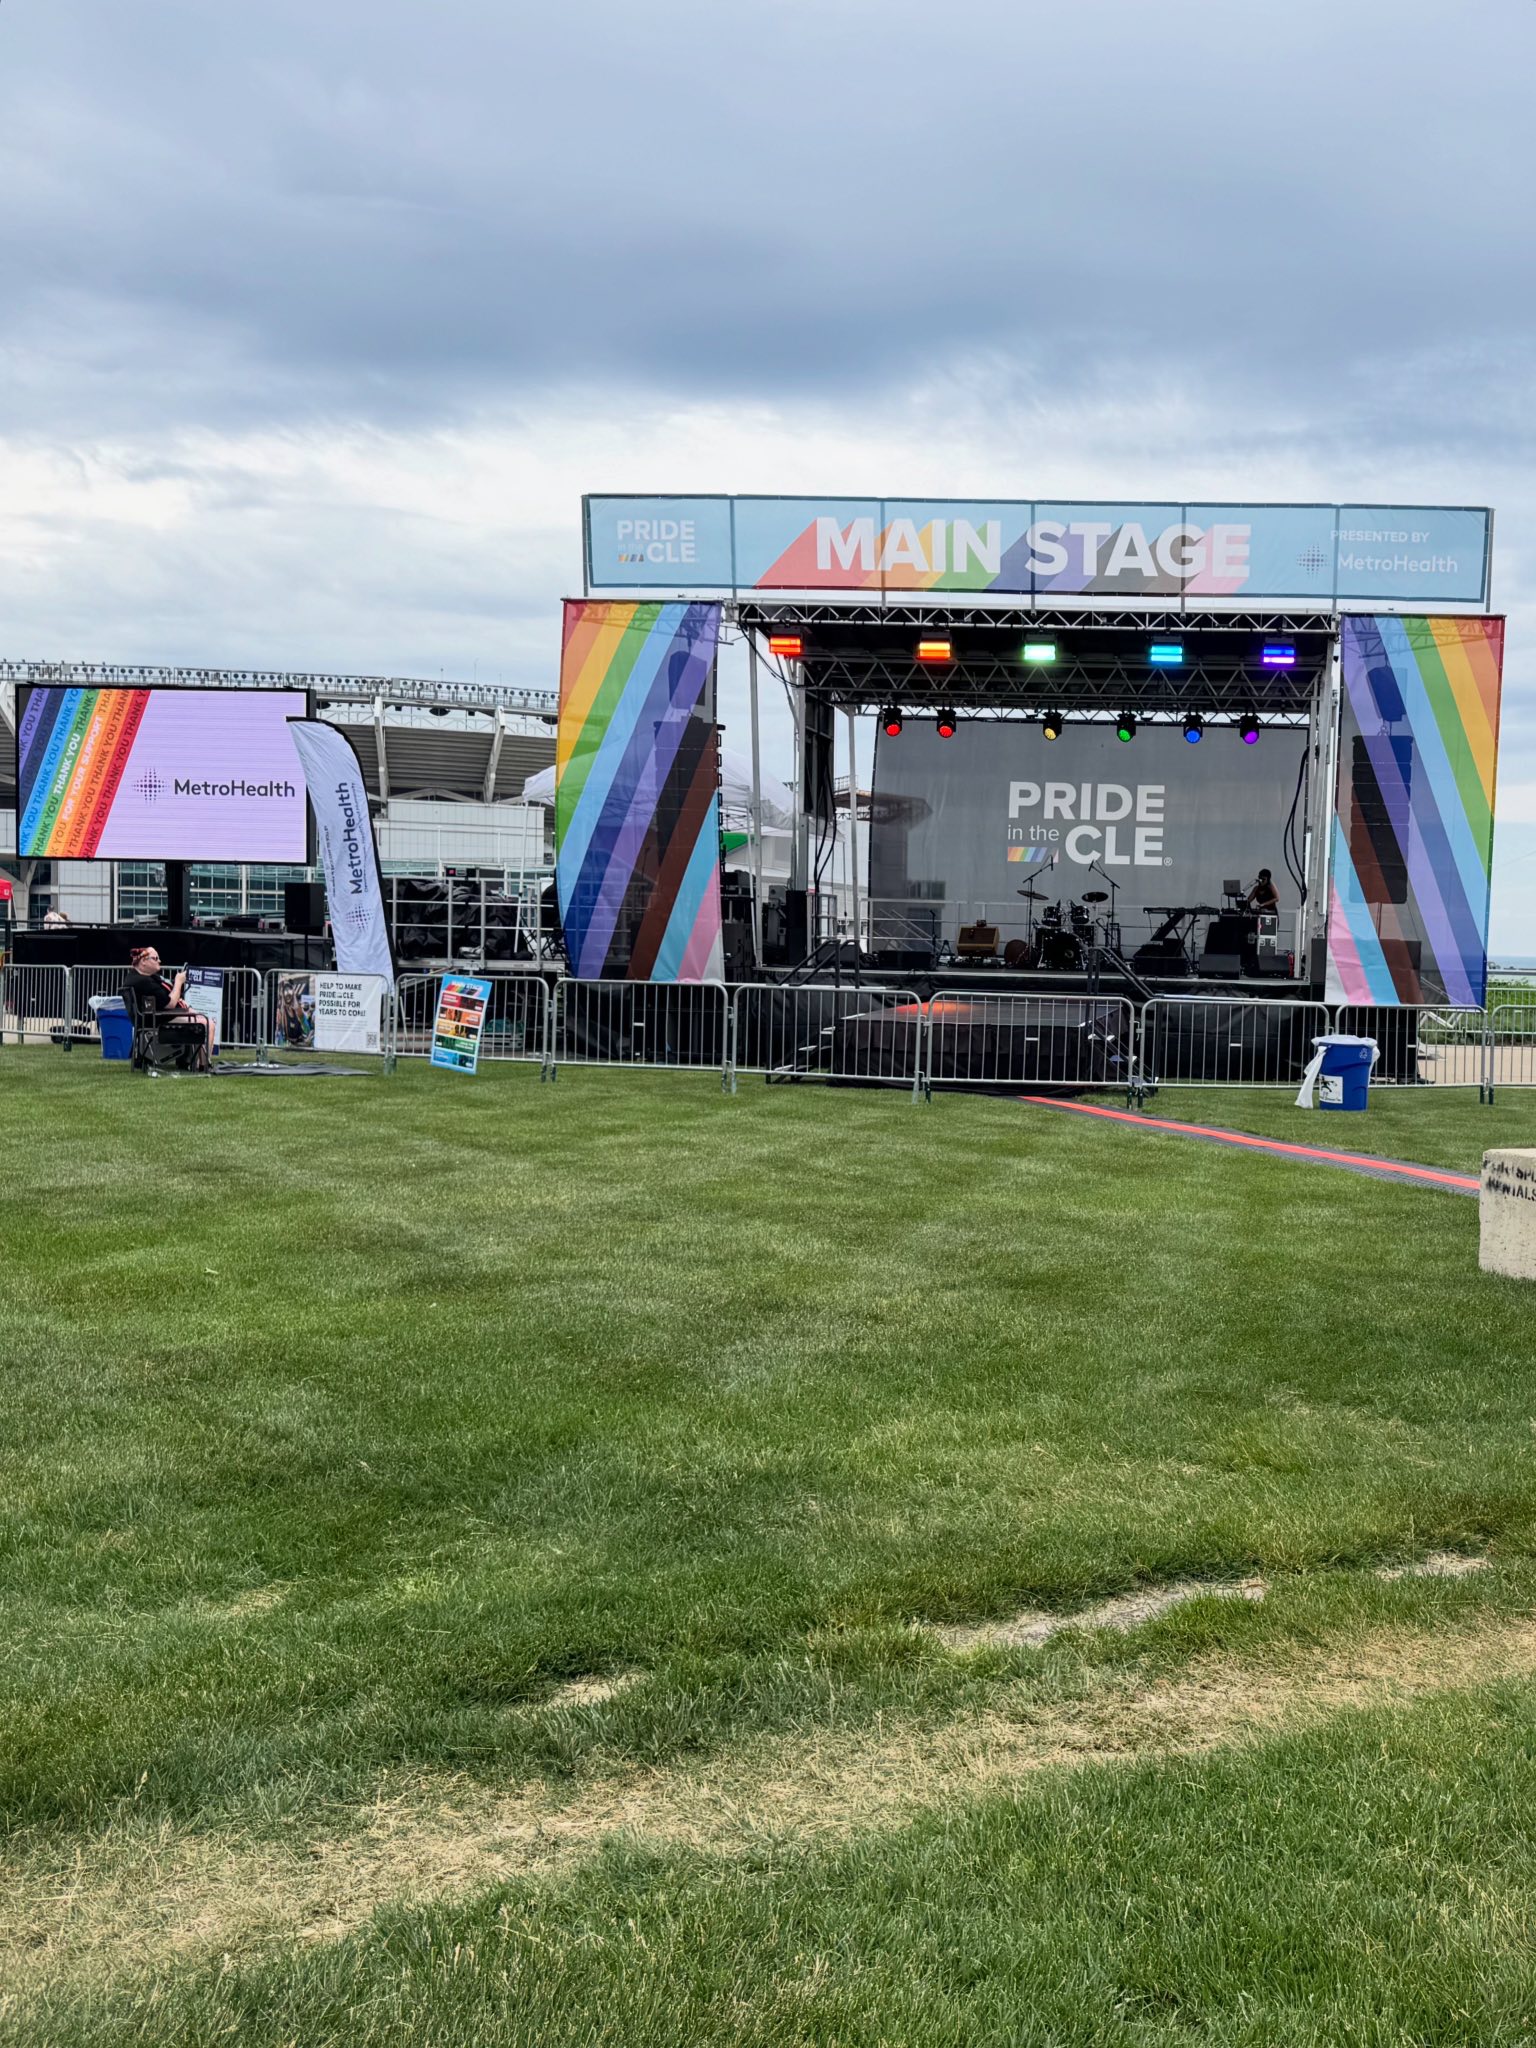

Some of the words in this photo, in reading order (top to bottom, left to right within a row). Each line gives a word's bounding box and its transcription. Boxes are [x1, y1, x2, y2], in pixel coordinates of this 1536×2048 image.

[617, 519, 695, 540] PRIDE
[1330, 529, 1409, 543] PRESENTED
[1411, 531, 1430, 544] BY
[647, 541, 695, 563] CLE
[817, 516, 1001, 574] MAIN
[1024, 520, 1251, 578] STAGE
[1337, 552, 1458, 574] MetroHealth
[23, 713, 35, 737] YOU
[24, 805, 38, 830] YOU
[33, 767, 51, 805] THANK
[46, 742, 59, 767] YOU
[54, 704, 72, 742] THANK
[45, 795, 59, 820] YOU
[53, 757, 71, 794] THANK
[66, 732, 80, 757] YOU
[74, 694, 93, 733] THANK
[94, 800, 107, 825] YOU
[103, 762, 120, 800] THANK
[116, 738, 129, 762] YOU
[124, 700, 142, 737] THANK
[54, 821, 66, 844] YOU
[62, 797, 74, 820] FOR
[70, 766, 85, 796] YOUR
[81, 714, 102, 765] SUPPORT
[69, 811, 86, 848] THANK
[82, 786, 95, 811] YOU
[91, 748, 108, 785] THANK
[104, 722, 117, 747] YOU
[174, 778, 295, 798] MetroHealth
[1008, 781, 1165, 822] PRIDE
[335, 782, 363, 894] MetroHealth
[1008, 825, 1025, 841] in
[1029, 824, 1060, 841] the
[1065, 825, 1164, 865] CLE
[319, 982, 334, 990] HELP
[345, 983, 362, 991] MAKE
[319, 991, 336, 999] PRIDE
[347, 1000, 361, 1008] FOR
